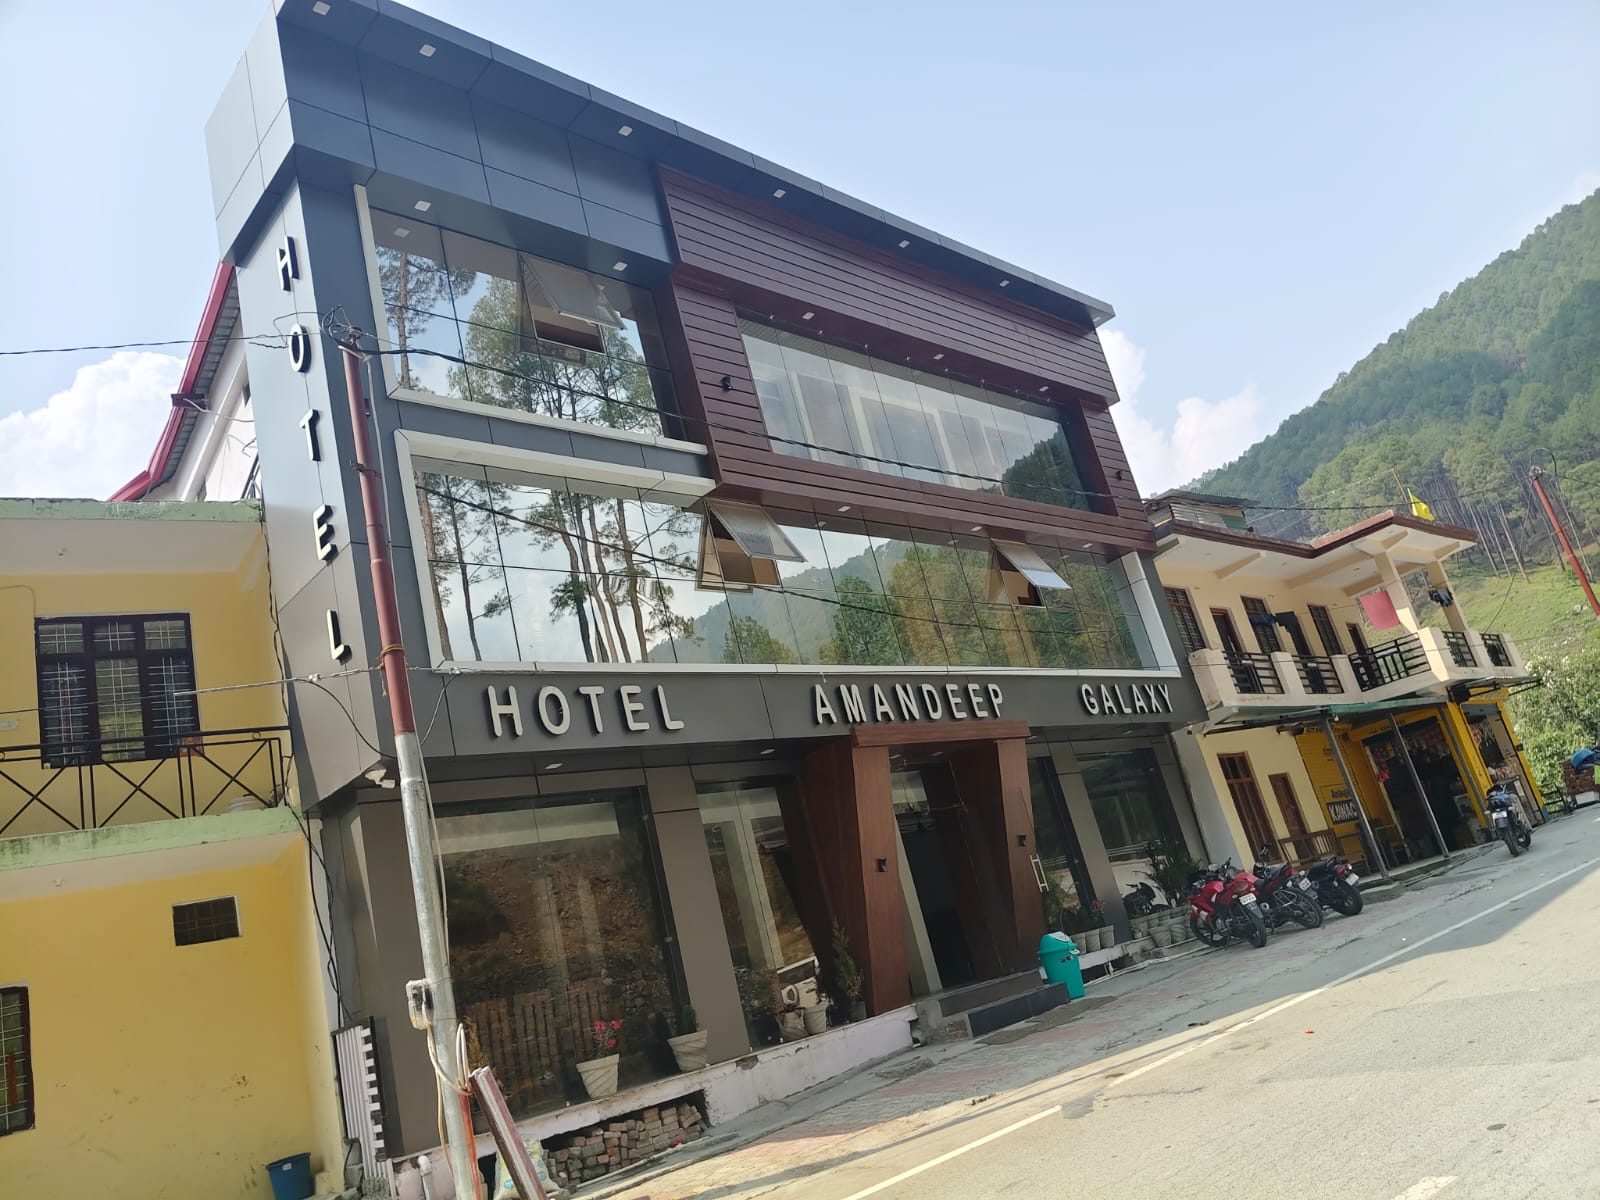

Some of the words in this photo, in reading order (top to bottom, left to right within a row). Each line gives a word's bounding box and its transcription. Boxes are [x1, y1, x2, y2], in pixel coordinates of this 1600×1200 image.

[275, 234, 352, 665] HOTEL
[486, 684, 685, 737] HOTEL
[813, 683, 1004, 725] AMANDEEP
[1079, 683, 1174, 716] GALAXY
